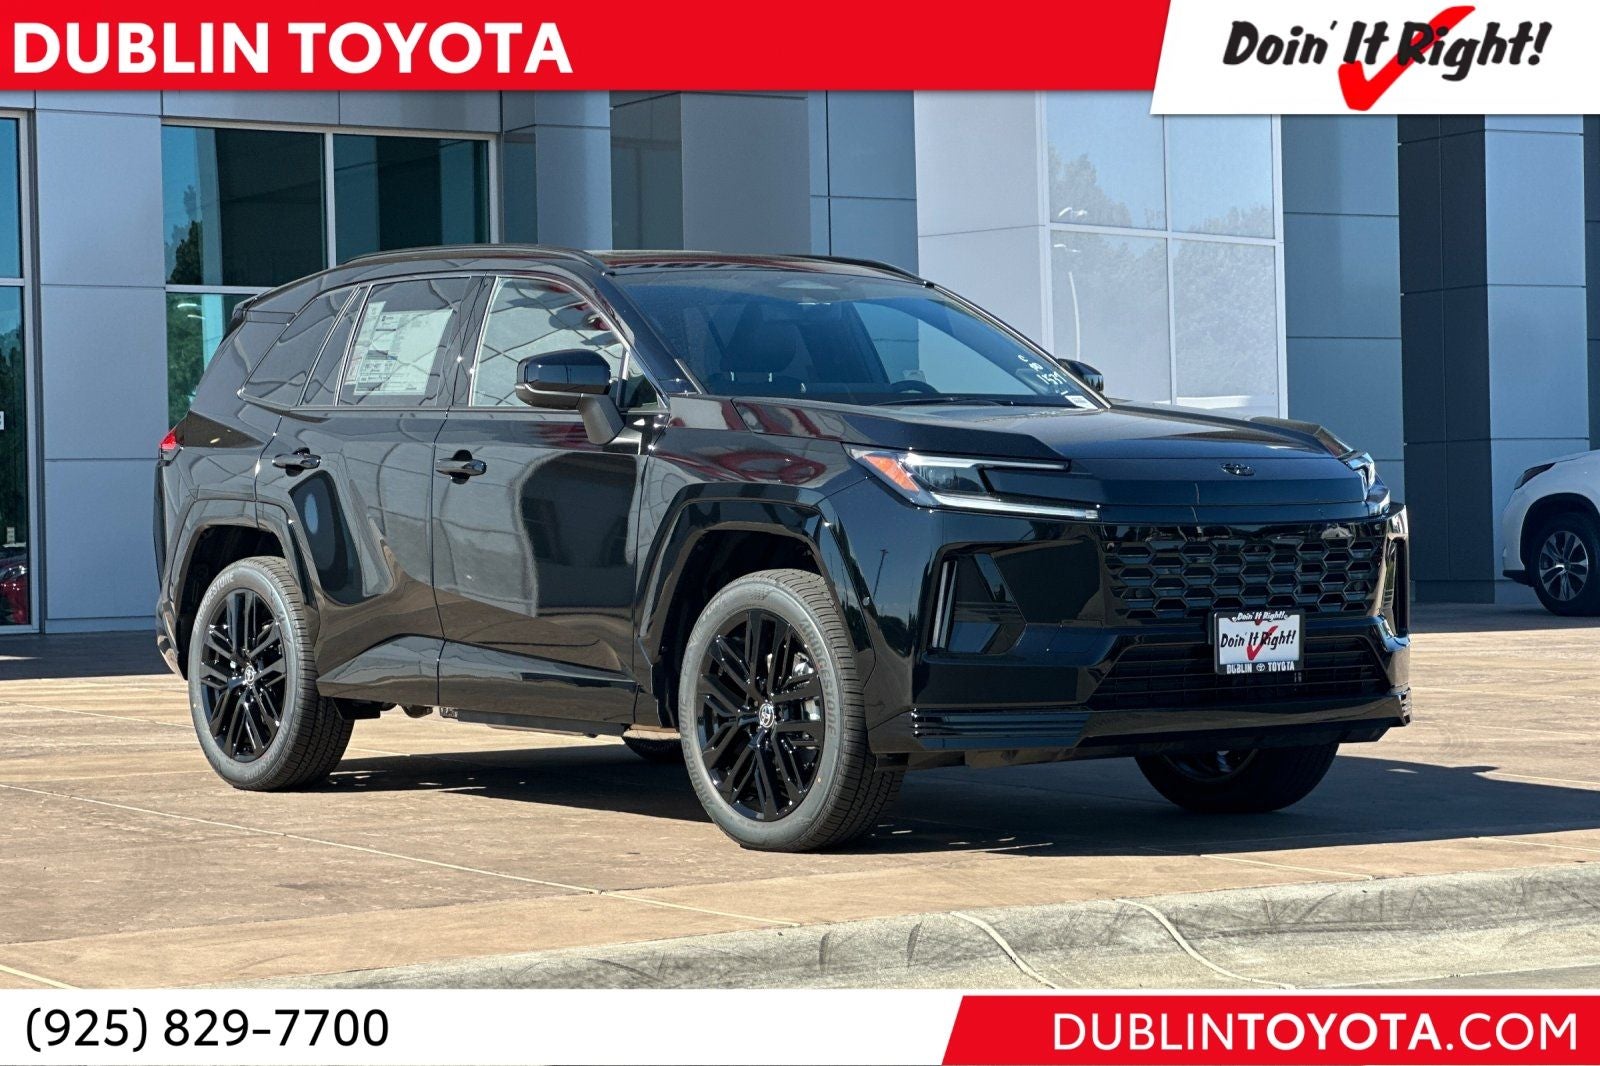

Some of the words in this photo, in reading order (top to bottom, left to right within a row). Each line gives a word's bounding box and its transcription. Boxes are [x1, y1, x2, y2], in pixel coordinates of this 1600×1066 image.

[193, 571, 234, 634] BRIDGESTONE
[1254, 611, 1262, 620] It
[1220, 632, 1247, 648] Doin'
[1248, 632, 1259, 646] It
[1261, 630, 1297, 650] Right!
[1226, 663, 1253, 675] DUBLIN
[1267, 661, 1295, 672] TOYOTA
[800, 620, 836, 737] BRIDGESTONE
